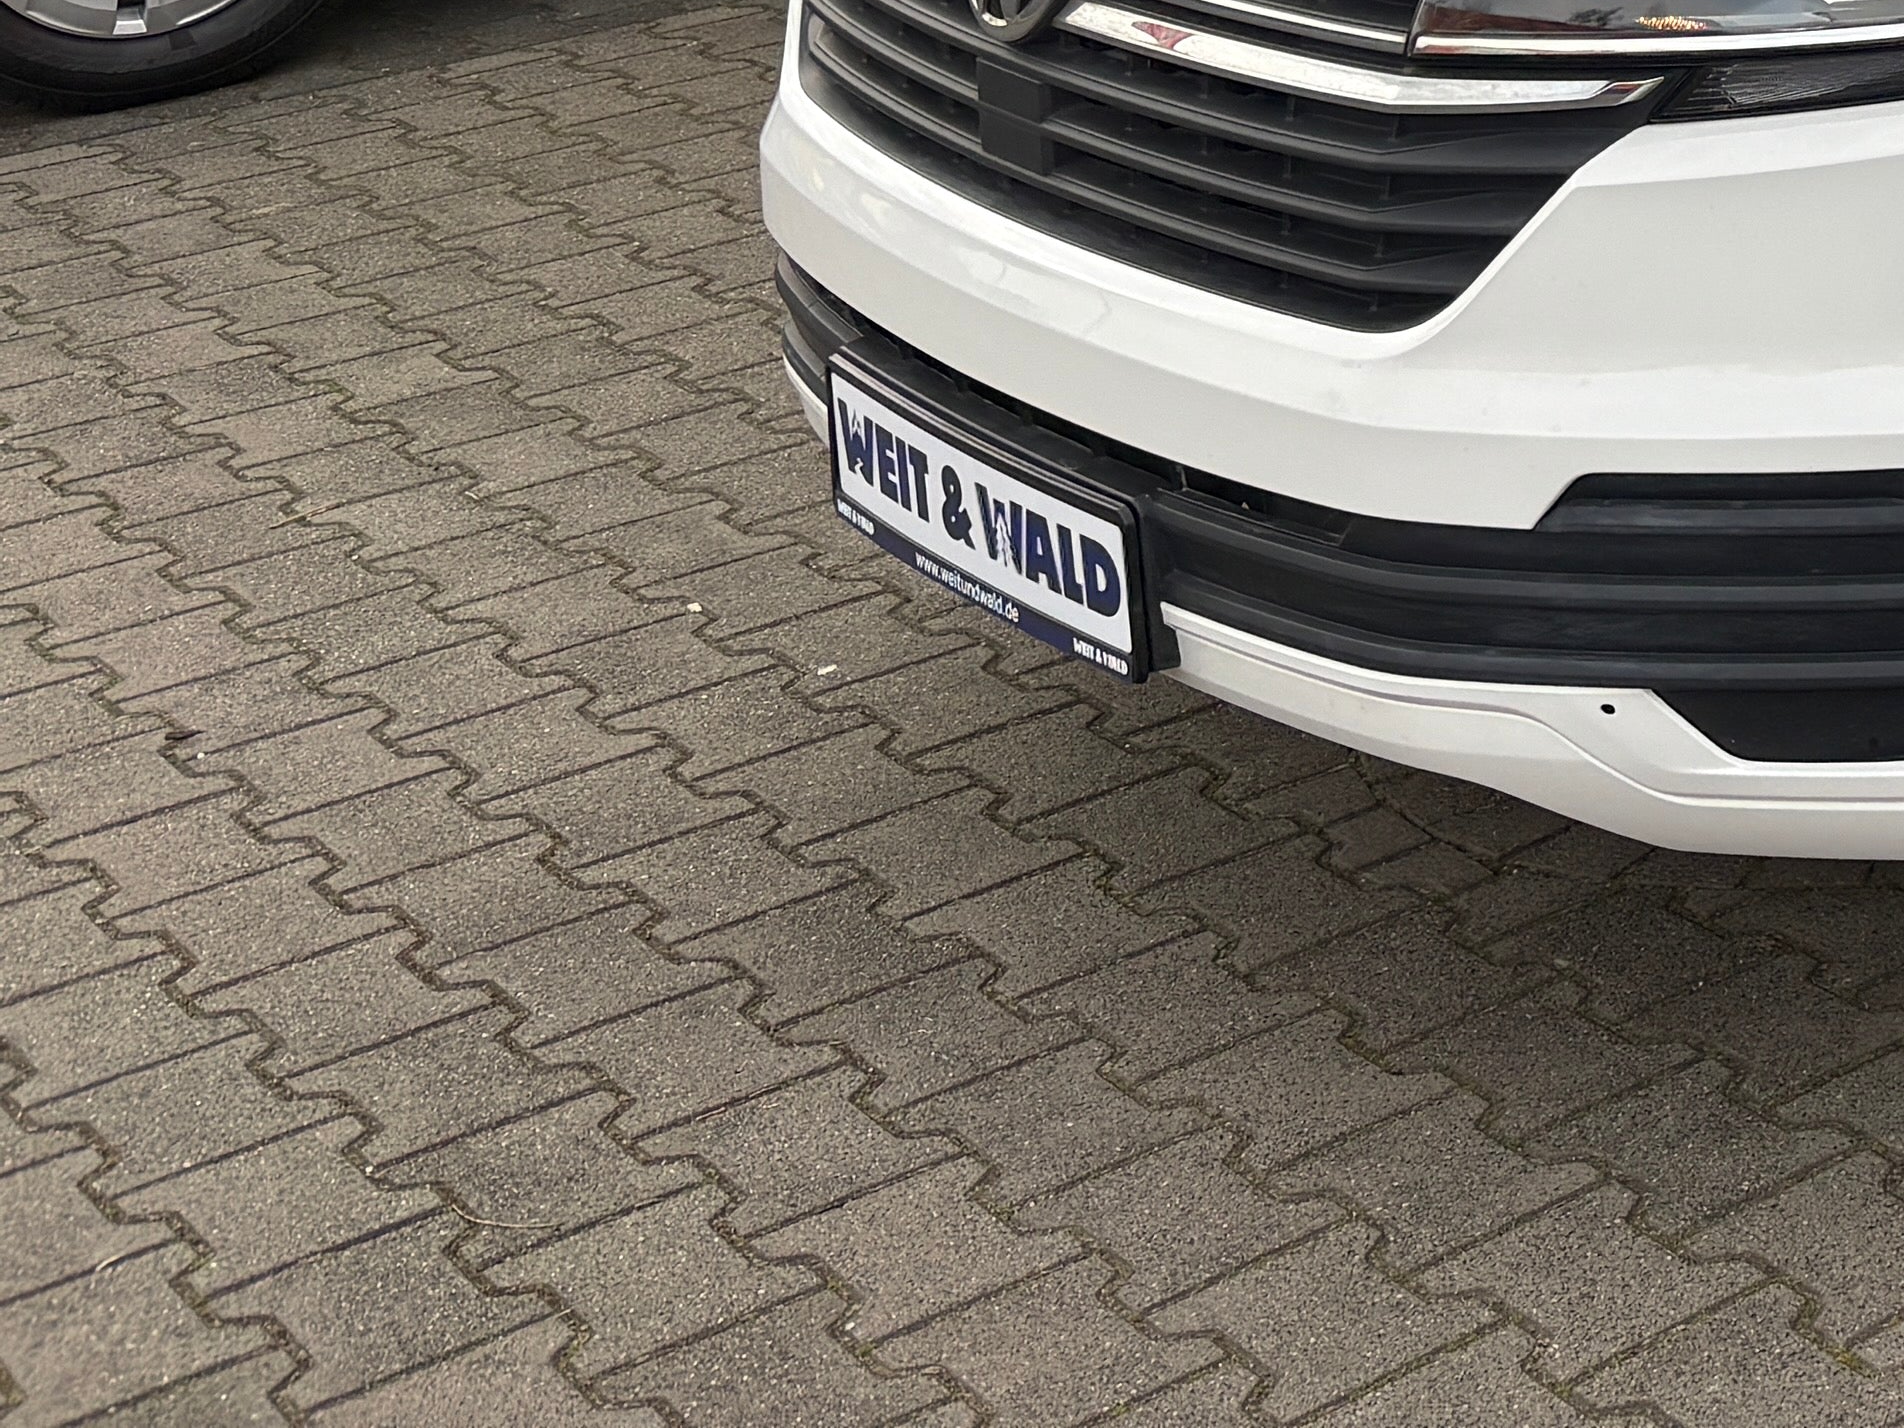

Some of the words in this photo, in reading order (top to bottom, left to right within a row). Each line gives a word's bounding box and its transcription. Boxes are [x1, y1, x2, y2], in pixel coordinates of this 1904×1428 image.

[837, 398, 930, 523] WEIT
[940, 465, 976, 551] &
[975, 481, 1121, 618] WALD
[915, 551, 1020, 624] www.weitundwald.de
